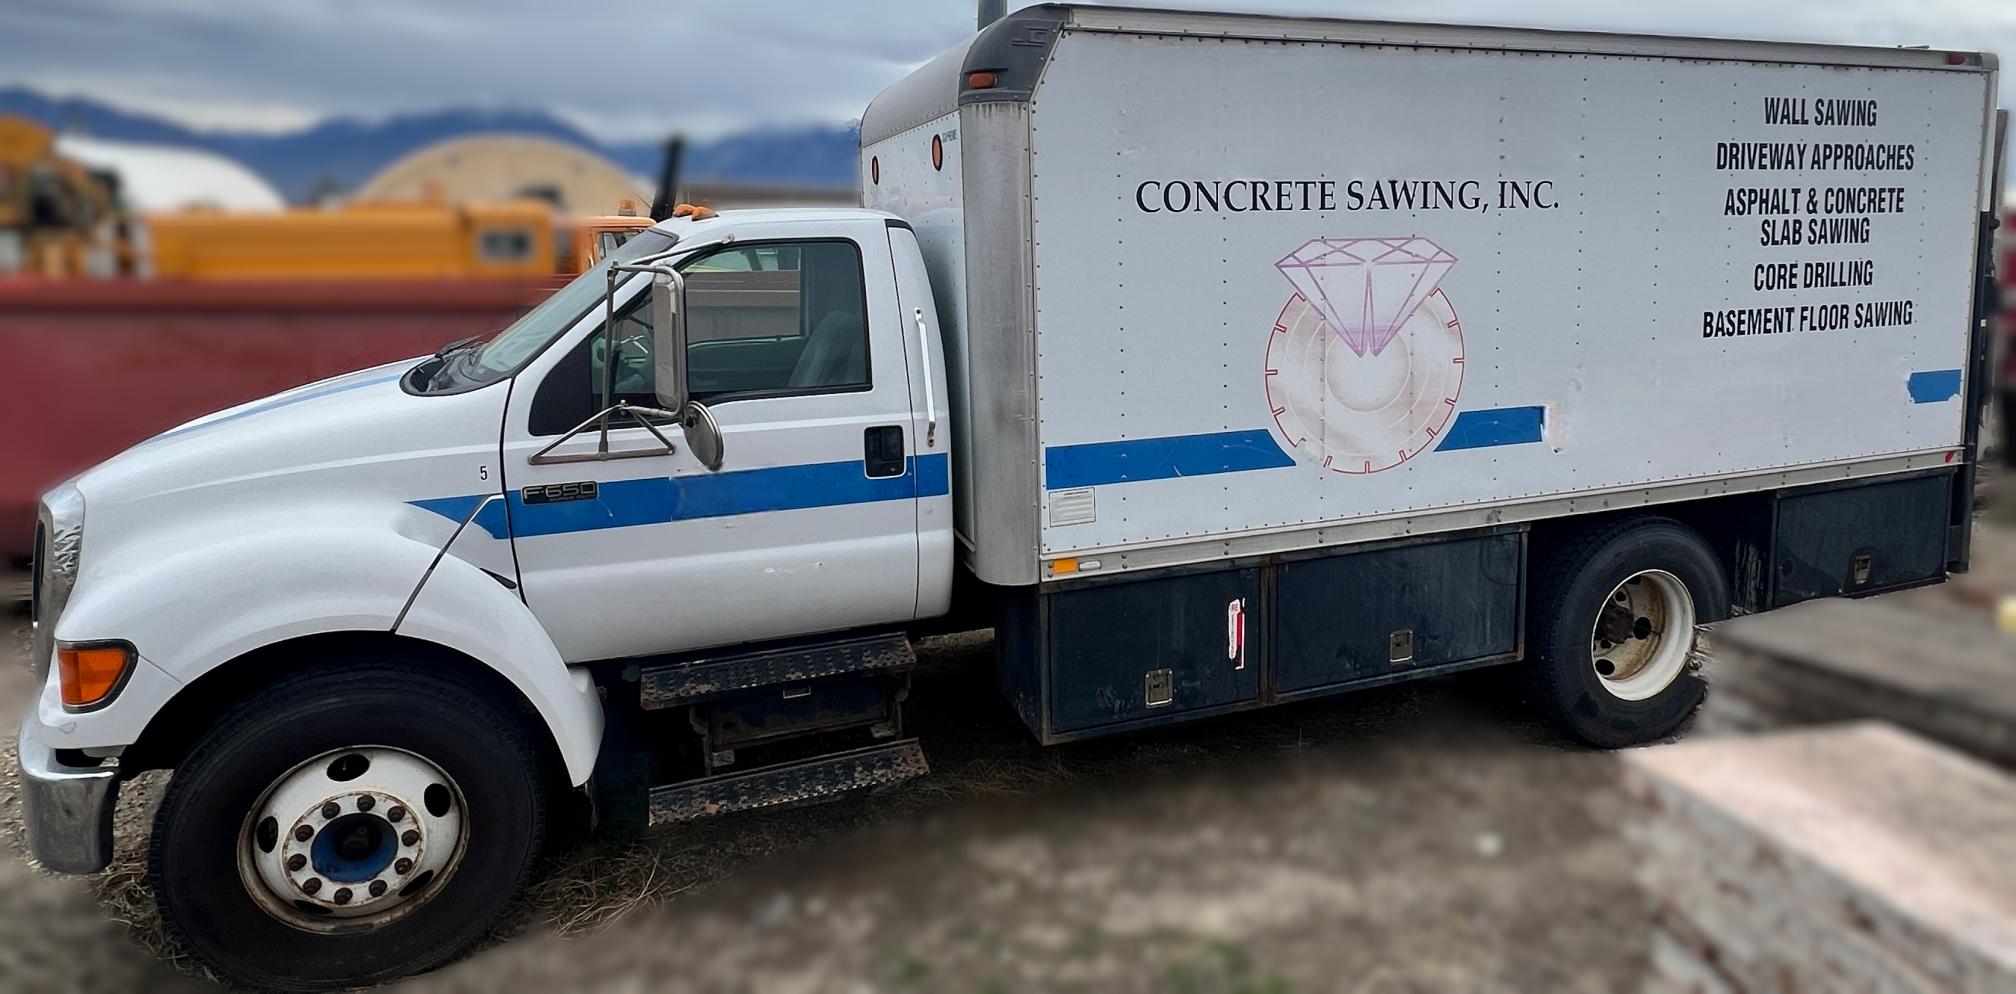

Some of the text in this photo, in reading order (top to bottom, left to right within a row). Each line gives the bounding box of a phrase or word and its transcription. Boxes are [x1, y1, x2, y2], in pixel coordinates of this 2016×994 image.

[1764, 96, 1878, 127] WALL SAWING
[1716, 142, 1915, 171] DRIVEWAY APPROACHES
[1136, 179, 1560, 214] CONCRETE SAWING, INC.
[1723, 187, 1905, 216] ASPHALT & CONCRETE
[1760, 217, 1870, 247] SLAB SAWING
[1754, 260, 1874, 291] CORE DRILLING
[1702, 300, 1913, 339] BASEMENT FLOOR SAWING
[480, 466, 488, 480] 5
